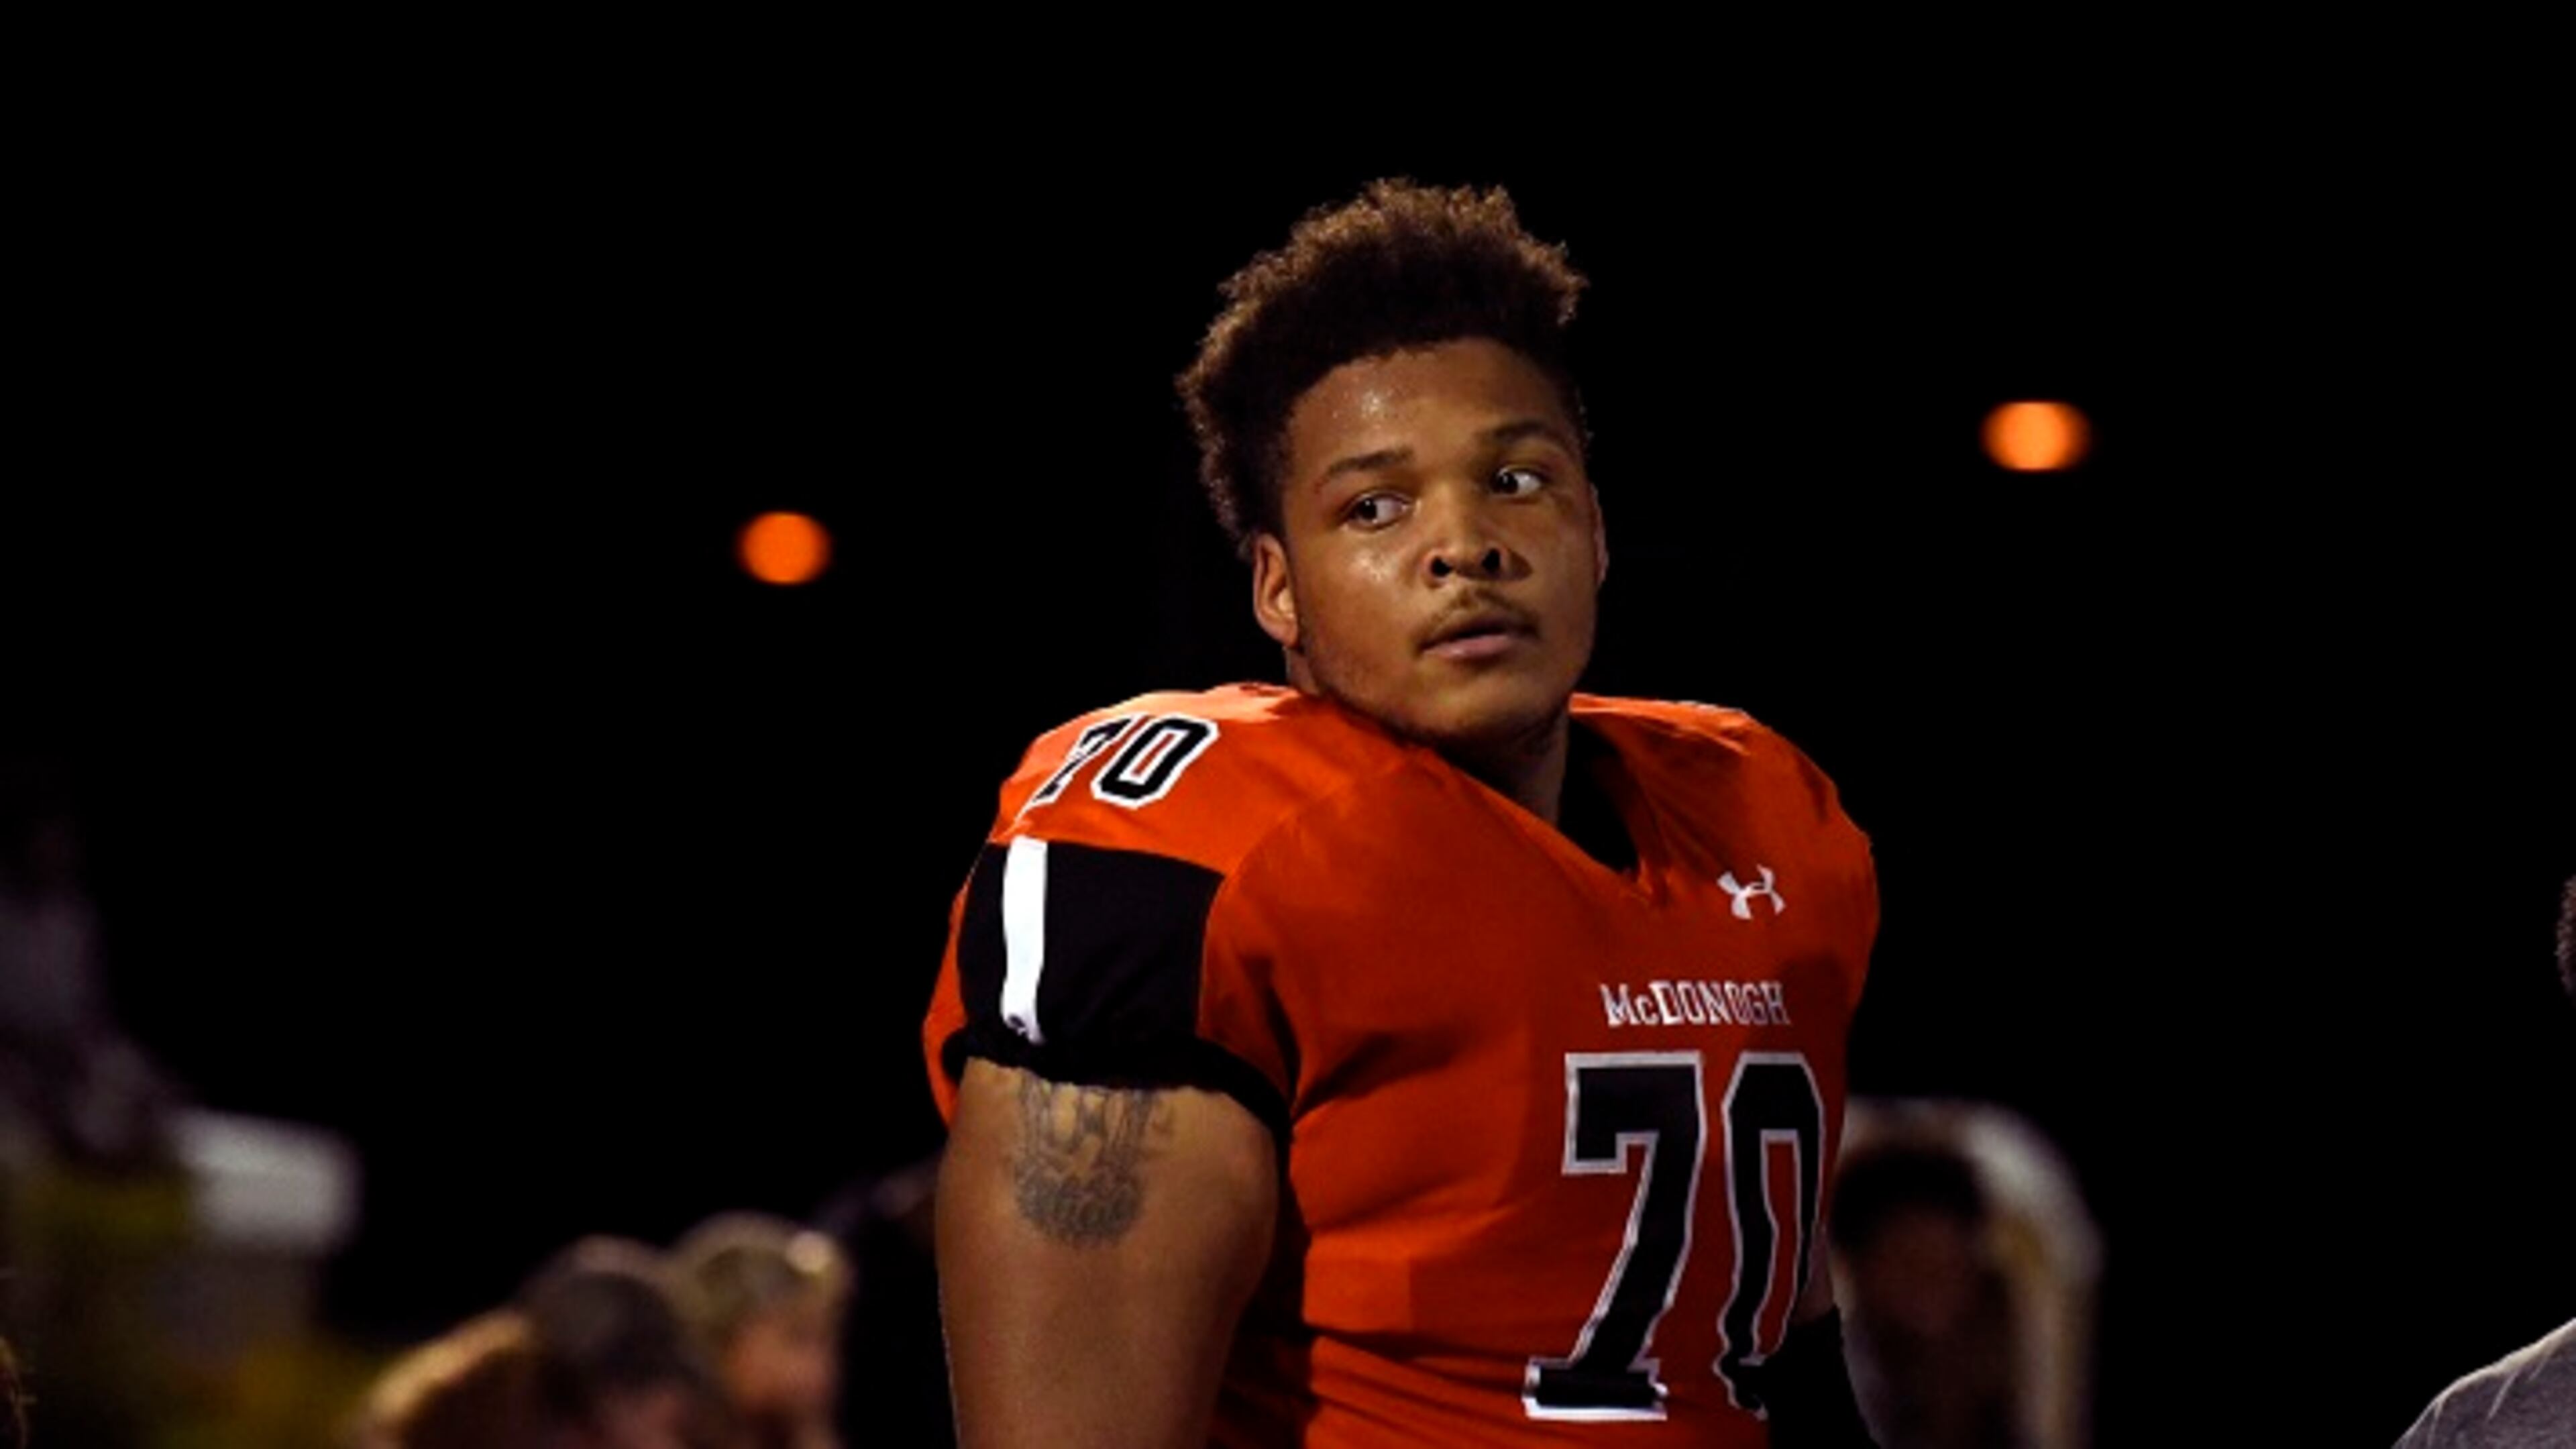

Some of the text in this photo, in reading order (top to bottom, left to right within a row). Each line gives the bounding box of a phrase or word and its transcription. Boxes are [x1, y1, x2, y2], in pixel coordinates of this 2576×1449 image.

[1018, 714, 1220, 811] 70
[1600, 979, 1792, 1026] McDONOGH
[1521, 1050, 1826, 1421] 70
